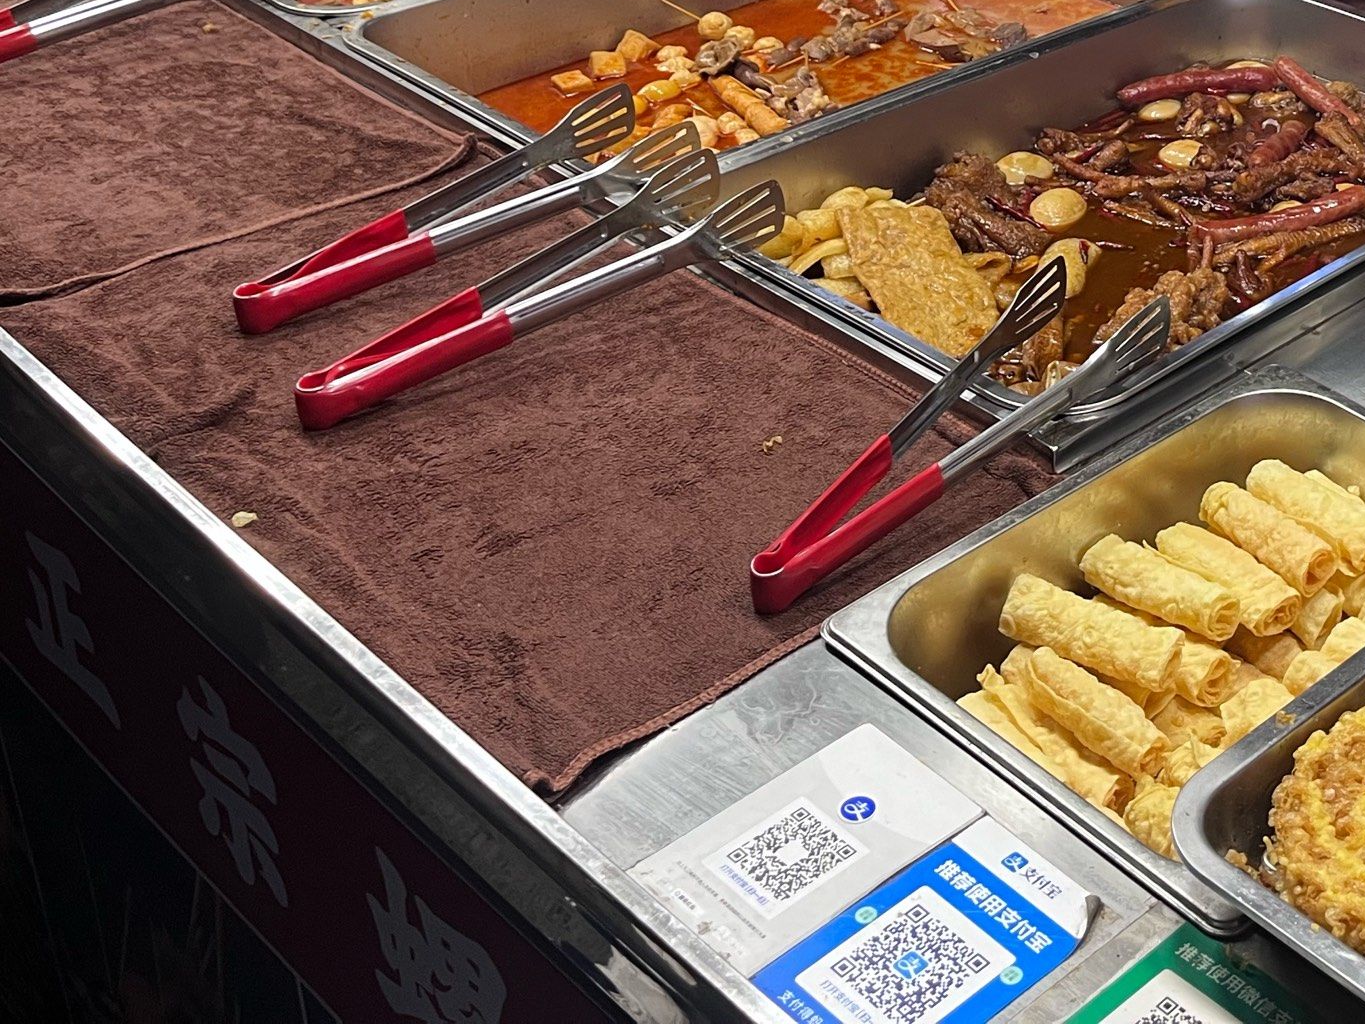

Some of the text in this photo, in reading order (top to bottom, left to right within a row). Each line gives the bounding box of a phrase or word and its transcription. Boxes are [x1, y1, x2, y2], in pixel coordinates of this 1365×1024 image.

[933, 858, 1054, 955] 推荐使用支付宝
[1019, 862, 1064, 900] 支付宝
